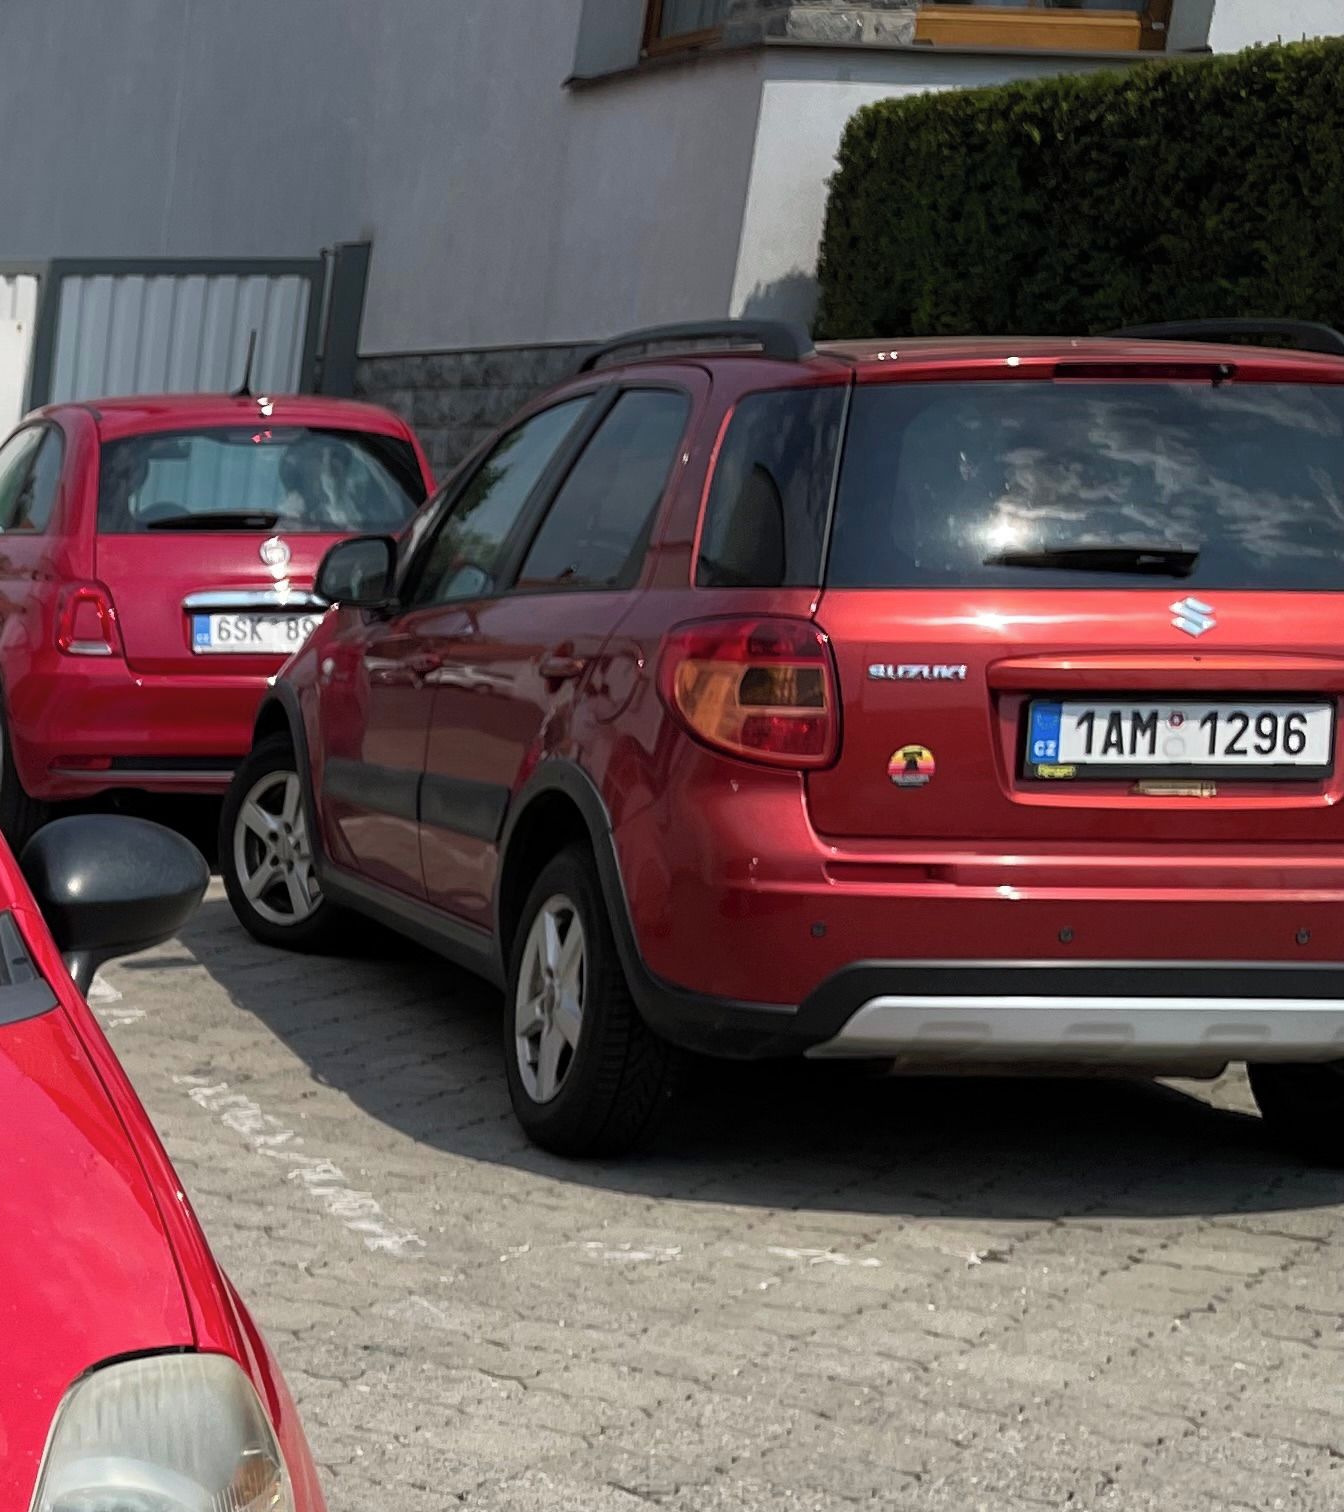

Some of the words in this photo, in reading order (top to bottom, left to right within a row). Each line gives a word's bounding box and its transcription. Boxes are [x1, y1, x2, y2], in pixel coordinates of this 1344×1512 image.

[218, 616, 262, 642] 6SK
[1076, 709, 1159, 756] 1AM
[1199, 710, 1308, 757] 1296
[1033, 739, 1057, 757] CZ
